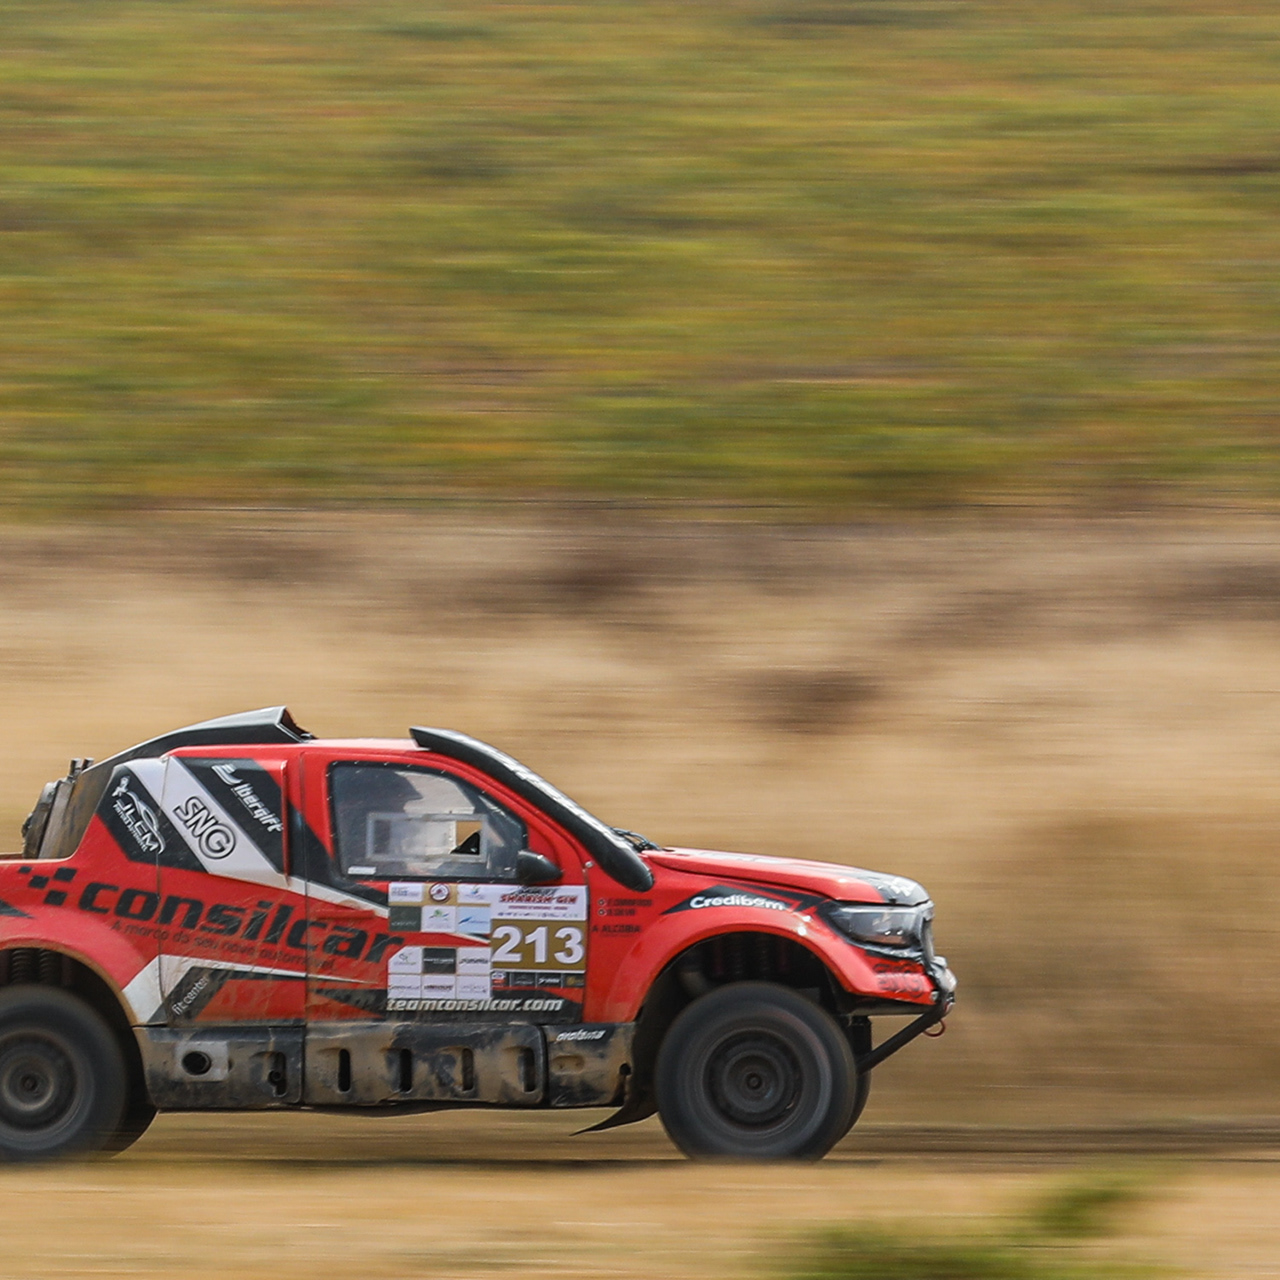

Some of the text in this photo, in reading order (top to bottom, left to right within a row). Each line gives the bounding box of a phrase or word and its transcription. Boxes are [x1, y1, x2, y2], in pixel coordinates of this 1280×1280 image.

[173, 796, 236, 859] SNG
[689, 894, 786, 912] Credibom
[78, 881, 404, 964] consilcar
[194, 936, 218, 949] seu
[491, 925, 585, 964] 213
[386, 998, 565, 1012] teamconsilcar.com
